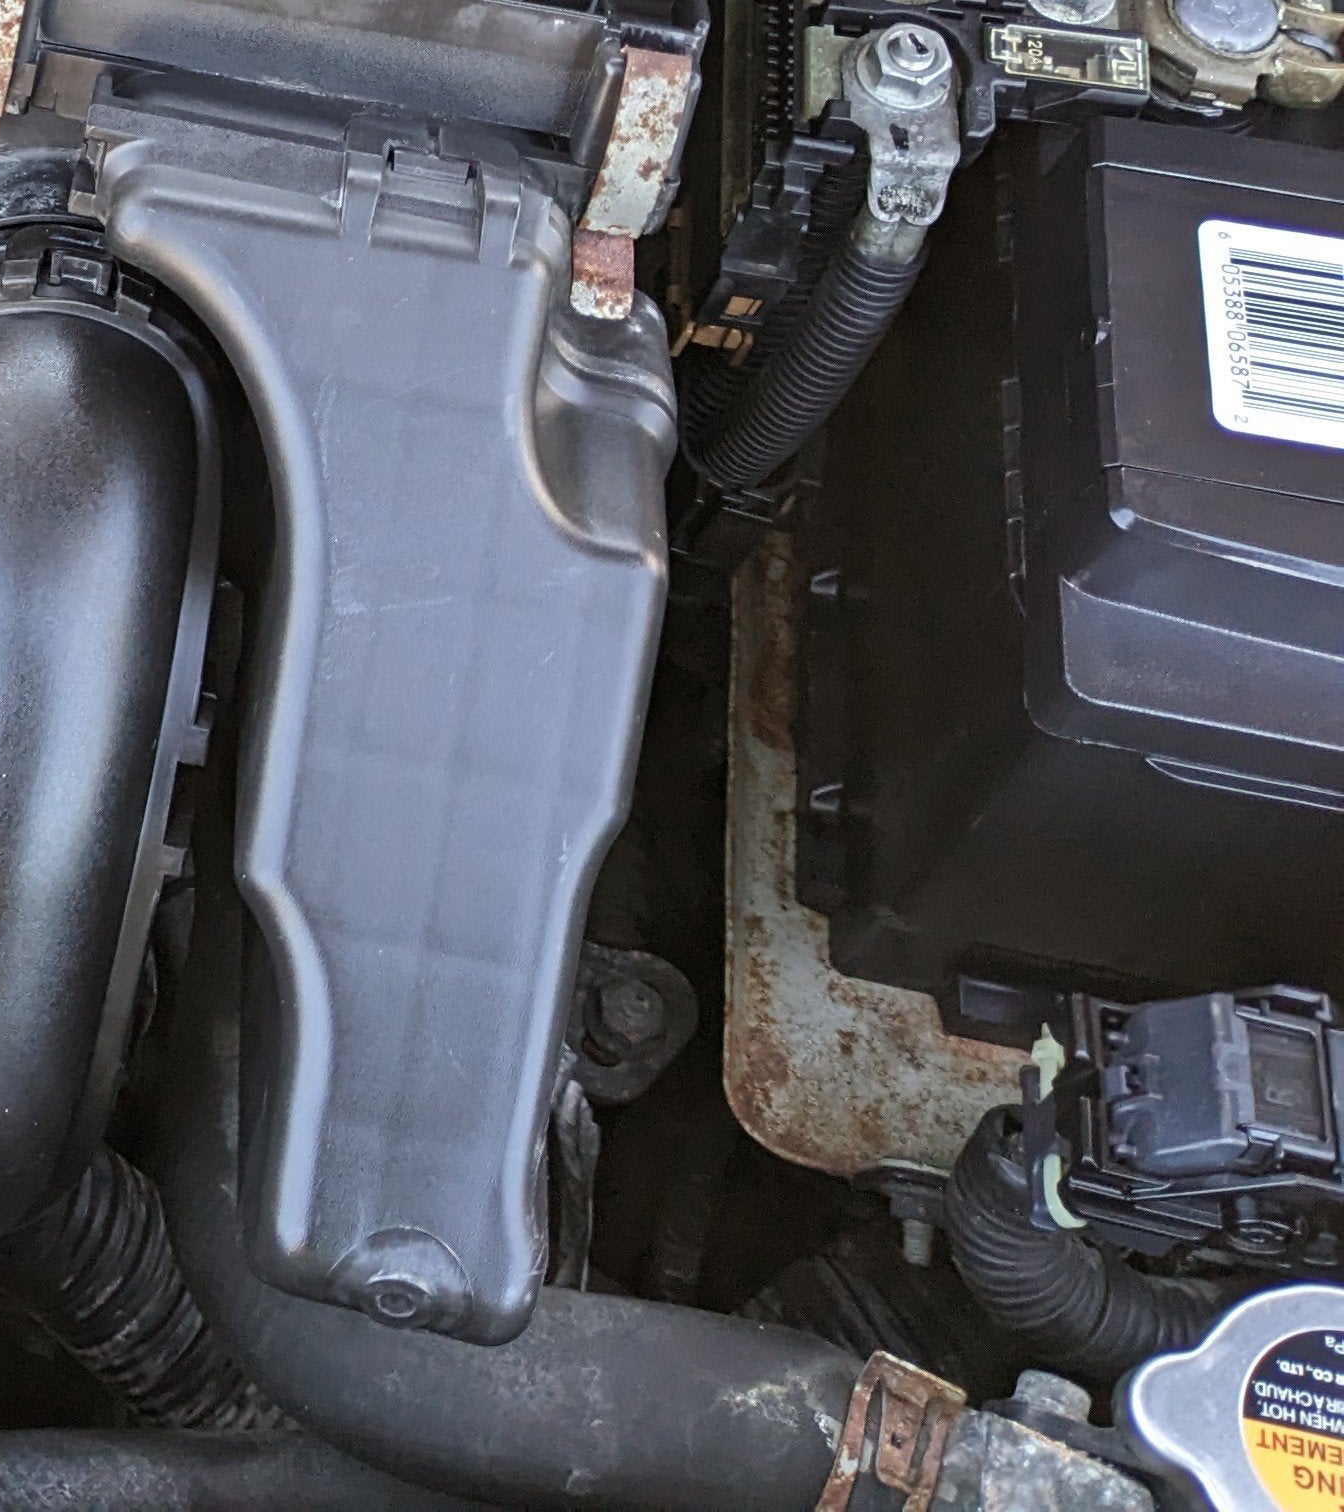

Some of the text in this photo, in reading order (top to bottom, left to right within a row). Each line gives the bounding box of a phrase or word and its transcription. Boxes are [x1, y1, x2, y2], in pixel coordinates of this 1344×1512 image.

[1218, 231, 1250, 424] 6 05388 06587 2
[1276, 1359, 1303, 1376] LTD.
[1306, 1364, 1333, 1382] CO.,
[1252, 1380, 1313, 1407] CHAUD.
[1255, 1400, 1296, 1423] HOT.
